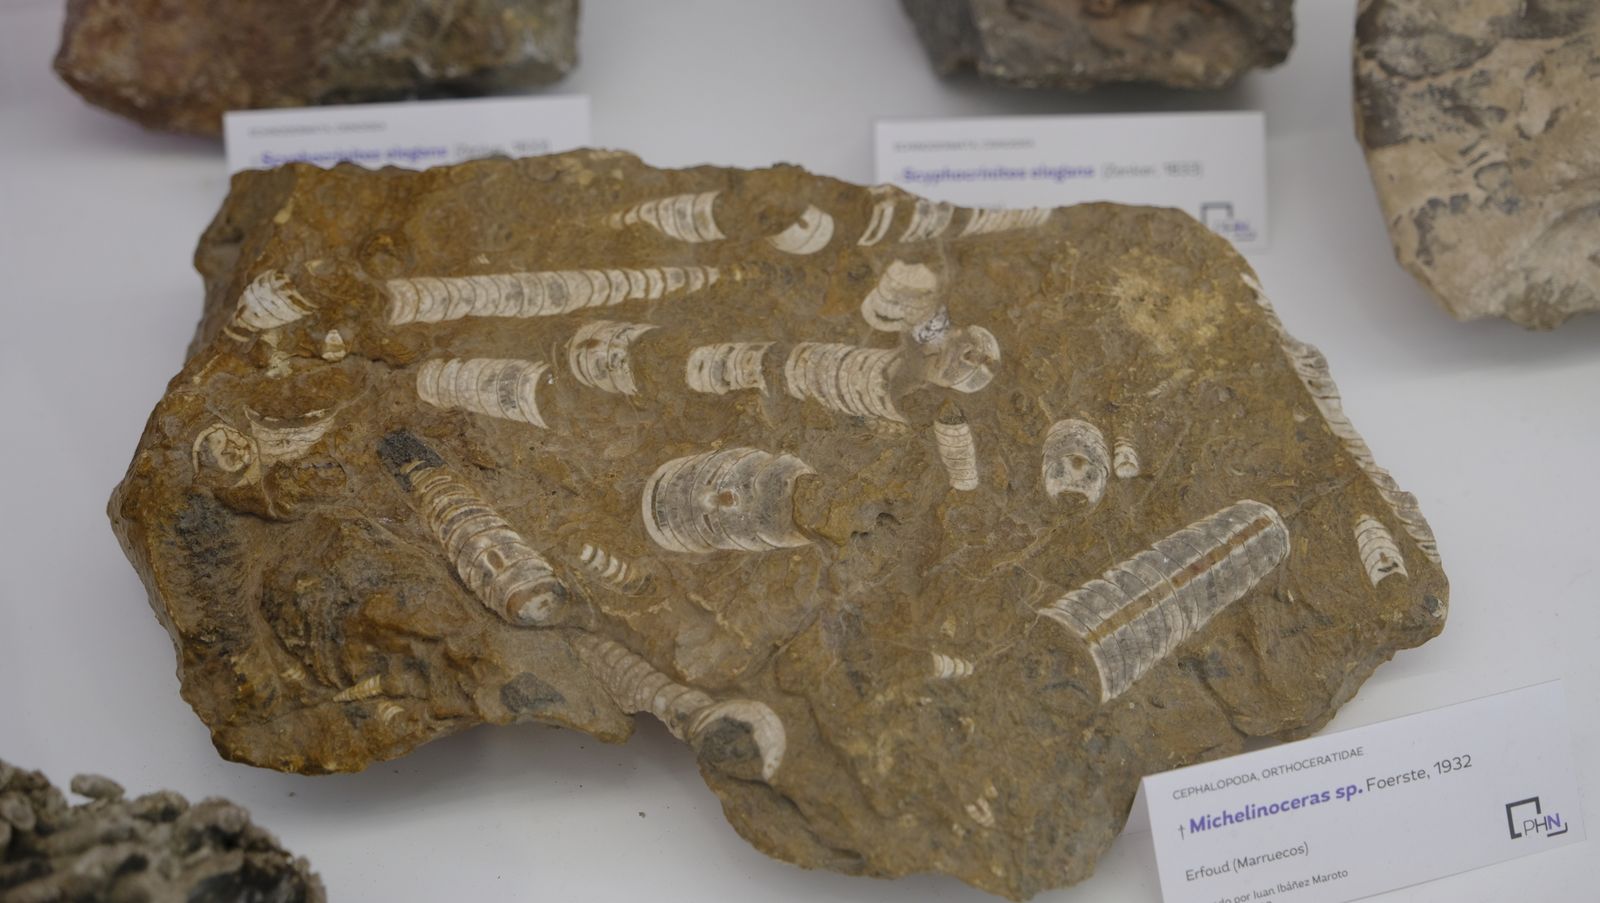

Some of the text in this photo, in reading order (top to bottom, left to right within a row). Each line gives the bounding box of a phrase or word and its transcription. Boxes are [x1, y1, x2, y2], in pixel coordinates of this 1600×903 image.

[1172, 747, 1364, 801] CEPHALOPODA, ORTHOCERATIDAE
[1189, 789, 1331, 834] Michelinoceras
[1335, 783, 1364, 802] sp.
[1366, 768, 1431, 792] Foerste,
[1433, 754, 1473, 775] 1932
[1523, 812, 1561, 837] PHN
[1185, 841, 1309, 882] Erfoud (Marruecos)
[1277, 878, 1310, 893] Ibáñez
[1311, 869, 1349, 885] Maroto
